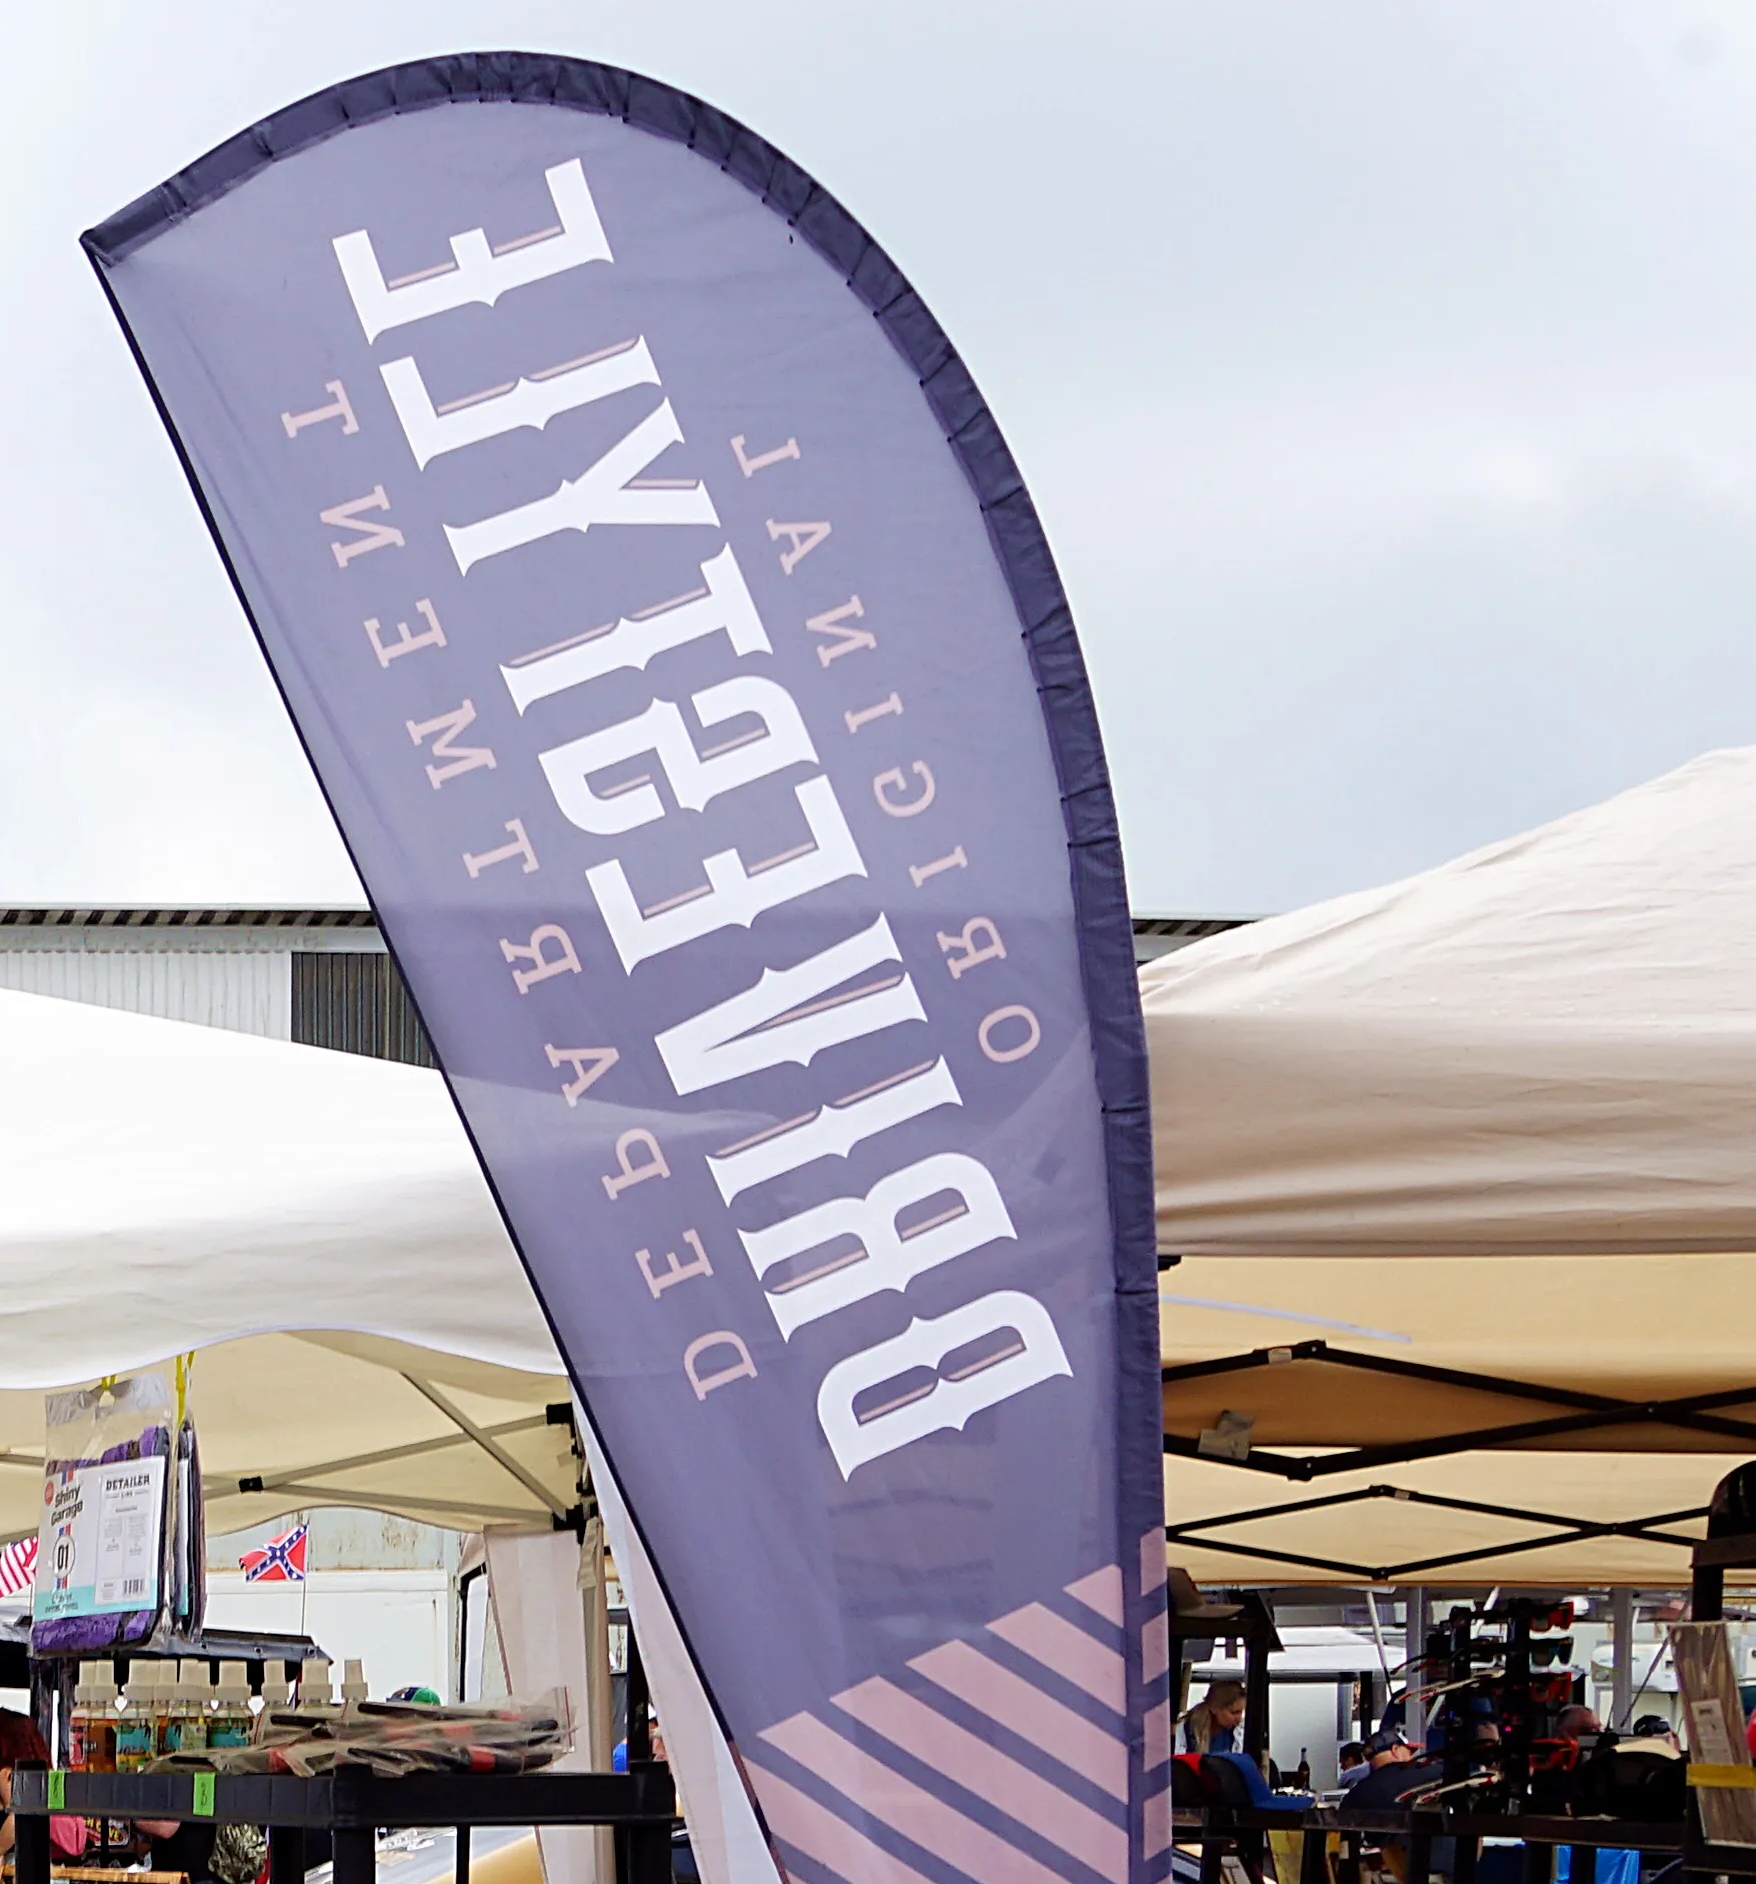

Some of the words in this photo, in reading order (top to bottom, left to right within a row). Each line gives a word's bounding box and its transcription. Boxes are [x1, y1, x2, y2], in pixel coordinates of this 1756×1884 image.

[105, 1474, 151, 1491] DETAILER
[54, 1484, 81, 1508] Shiny
[50, 1500, 84, 1527] Garage
[57, 1544, 70, 1570] 01
